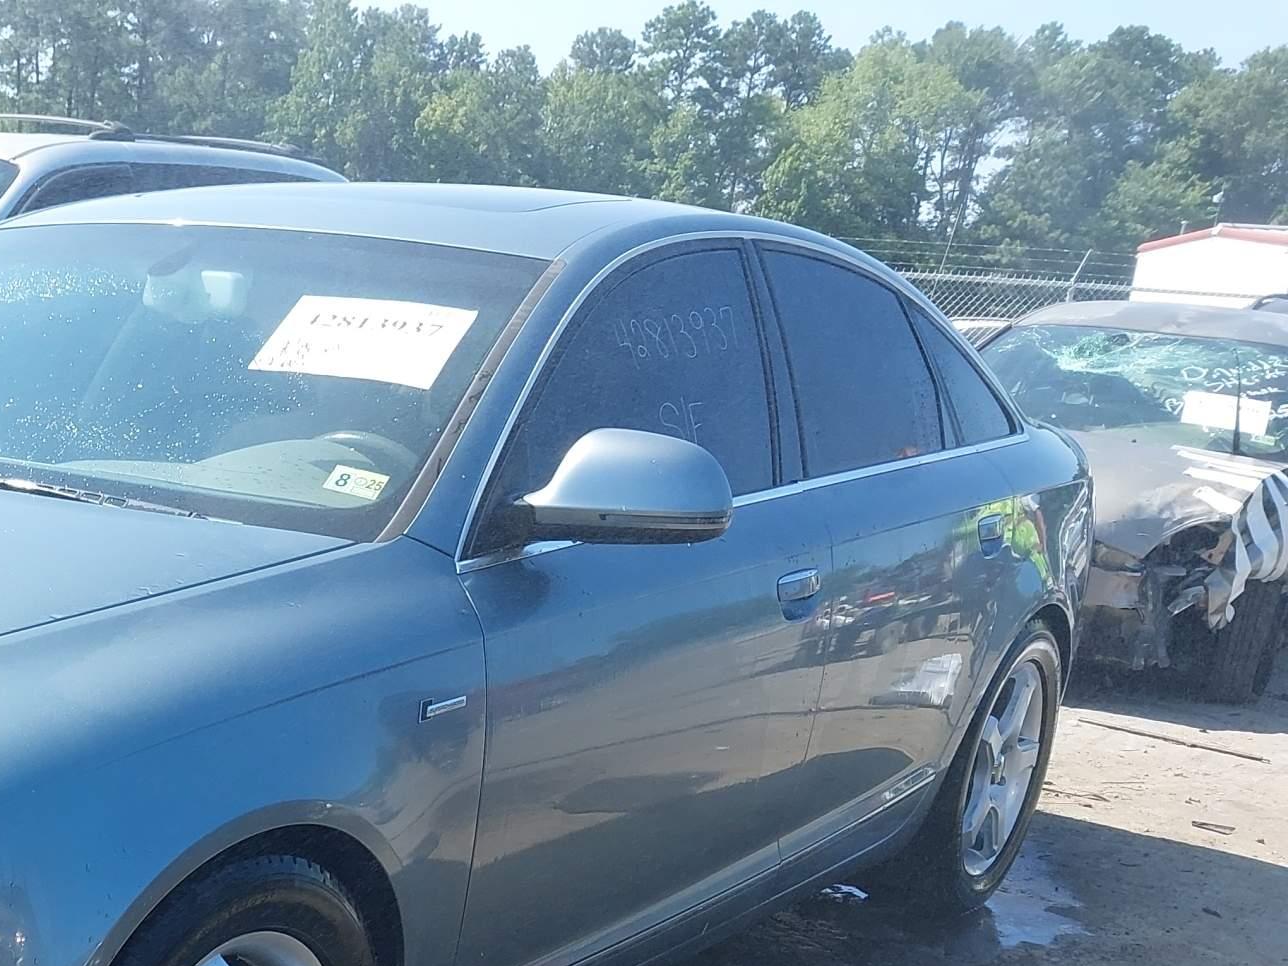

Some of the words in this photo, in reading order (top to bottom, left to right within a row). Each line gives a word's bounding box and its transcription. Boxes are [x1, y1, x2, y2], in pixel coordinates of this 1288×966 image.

[615, 306, 738, 368] 42813937
[335, 473, 351, 487] 8
[365, 479, 384, 491] 25
